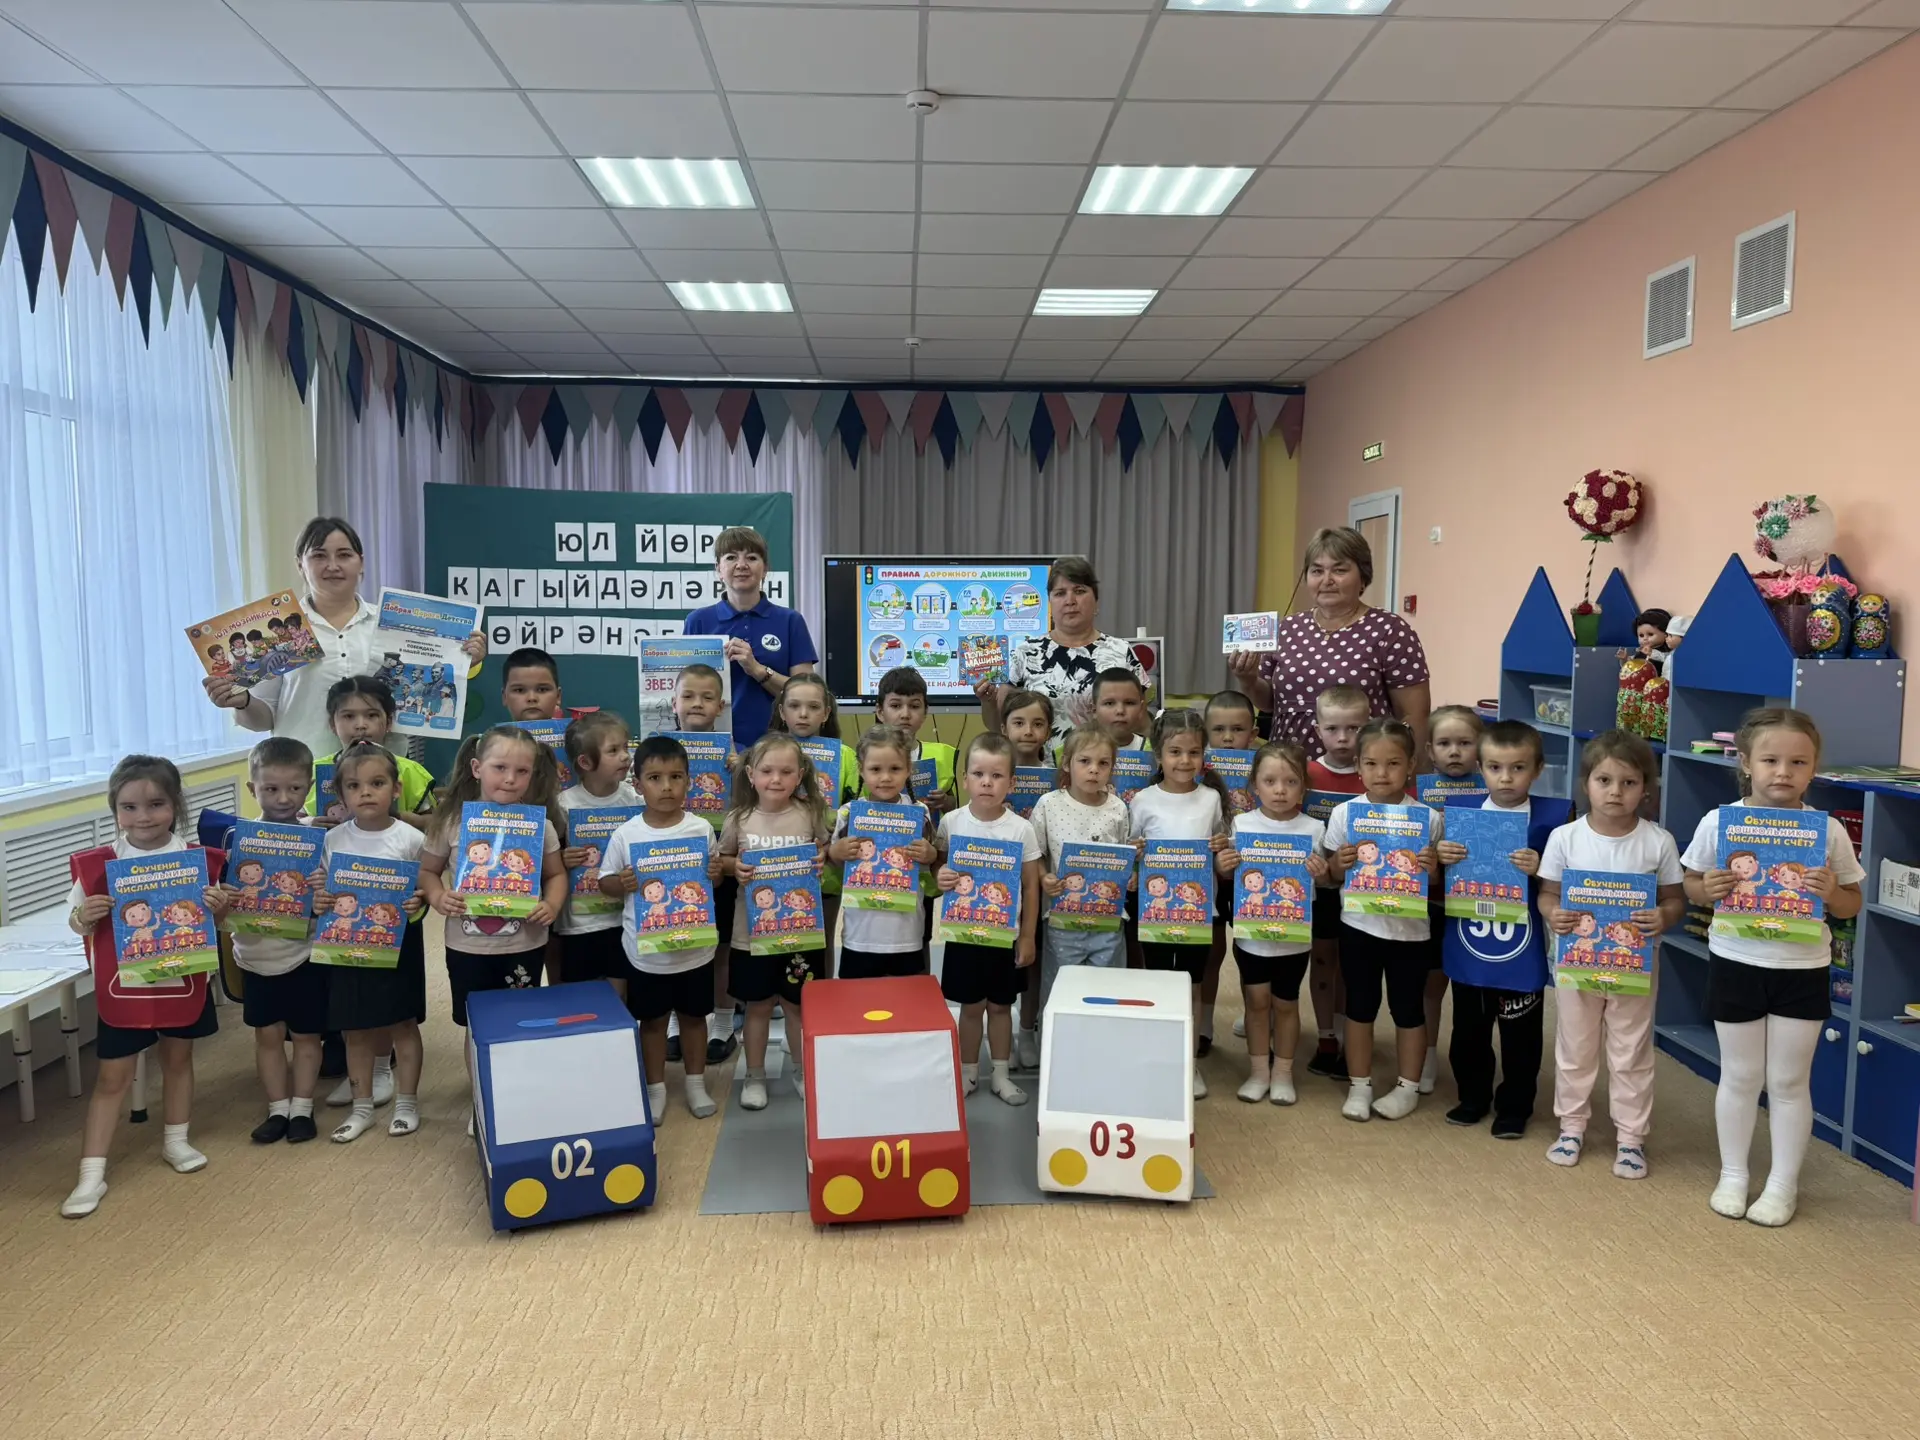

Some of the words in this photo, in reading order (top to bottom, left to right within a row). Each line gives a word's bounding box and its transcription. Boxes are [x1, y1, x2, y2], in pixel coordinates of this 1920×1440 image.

[558, 532, 609, 552] ЮЛ
[641, 529, 714, 552] ЙӨР
[453, 574, 782, 600] КАГЫЙДӘЛӘРН
[441, 613, 472, 625] Детства
[492, 621, 675, 646] ӨЙРӘН
[694, 648, 721, 656] Детства
[965, 654, 1004, 668] МАШИНЫ
[645, 678, 675, 691] ЗВЕЗ
[482, 809, 525, 819] ОБУЧЕНИЕ
[867, 808, 905, 819] ОБУЧЕНИЕ
[1367, 810, 1409, 820] ОБУЧЕНИЕ
[467, 817, 538, 828] ДОШКОЛЬНИКОВ
[854, 816, 916, 827] ДОШКОЛЬНИКОВ
[1744, 816, 1799, 828] ОБУЧЕНИЕ
[512, 827, 536, 836] СЧЁТУ
[855, 824, 884, 832] ЧИСЛАМ
[894, 826, 915, 834] СЧЁТУ
[1354, 826, 1387, 834] ЧИСЛАМ
[1398, 828, 1421, 836] СЧЁТУ
[1726, 825, 1817, 838] ДОШКОЛЬНИКОВ
[257, 830, 302, 841] ОБУЧЕНИЕ
[1727, 835, 1770, 844] ЧИСЛАМ
[1784, 837, 1815, 847] СЧЁТУ
[240, 837, 316, 851] ДОШКОЛЬНИКОВ
[967, 843, 1004, 854] ОБУЧЕНИЕ
[1157, 846, 1194, 854] ОБУЧЕНИЕ
[1254, 840, 1292, 849] ОБУЧЕНИЕ
[240, 846, 276, 855] ЧИСЛАМ
[287, 849, 313, 858] СЧЁТУ
[649, 846, 689, 856] ОБУЧЕНИЕ
[953, 850, 1016, 863] ДОШКОЛЬНИКОВ
[1079, 849, 1116, 858] ОБУЧЕНИЕ
[1241, 848, 1305, 857] ДОШКОЛЬНИКОВ
[637, 852, 703, 866] ДОШКОЛЬНИКОВ
[760, 855, 798, 864] ОБУЧЕНИЕ
[954, 858, 983, 867] ЧИСЛАМ
[993, 862, 1014, 870] СЧЁТУ
[1282, 856, 1304, 864] СЧЁТУ
[130, 861, 181, 874] ОБУЧЕНИЕ
[352, 862, 396, 874] ОБУЧЕНИЕ
[638, 864, 670, 873] ЧИСЛАМ
[680, 859, 702, 868] СЧЁТУ
[116, 867, 199, 887] ДОШКОЛЬНИКОВ
[334, 869, 409, 884] ДОШКОЛЬНИКОВ
[752, 872, 780, 880] ЧИСЛАМ
[790, 867, 811, 876] СЧЁТУ
[117, 883, 158, 894] ЧИСЛАМ
[170, 875, 198, 886] СЧЁТУ
[335, 878, 370, 887] ЧИСЛАМ
[381, 882, 406, 891] СЧЁТУ
[1584, 878, 1631, 889] ОБУЧЕНИЕ
[1460, 882, 1464, 890] 1
[1499, 888, 1505, 896] 4
[1514, 890, 1518, 898] 5
[1568, 887, 1647, 899] ДОШКОЛЬНИКОВ
[1568, 896, 1606, 904] ЧИСЛАМ
[1618, 898, 1645, 907] СЧЁТУ
[1733, 895, 1738, 905] 1
[1747, 898, 1753, 908] 2
[1766, 900, 1772, 909] 3
[1782, 902, 1789, 910] 4
[1802, 904, 1808, 912] 5
[133, 943, 139, 954] 1
[146, 943, 153, 953] 2
[164, 940, 171, 950] 3
[179, 937, 186, 946] 4
[196, 934, 204, 944] 5
[1090, 1120, 1136, 1159] 03
[551, 1138, 595, 1180] 02
[871, 1139, 910, 1179] 01
